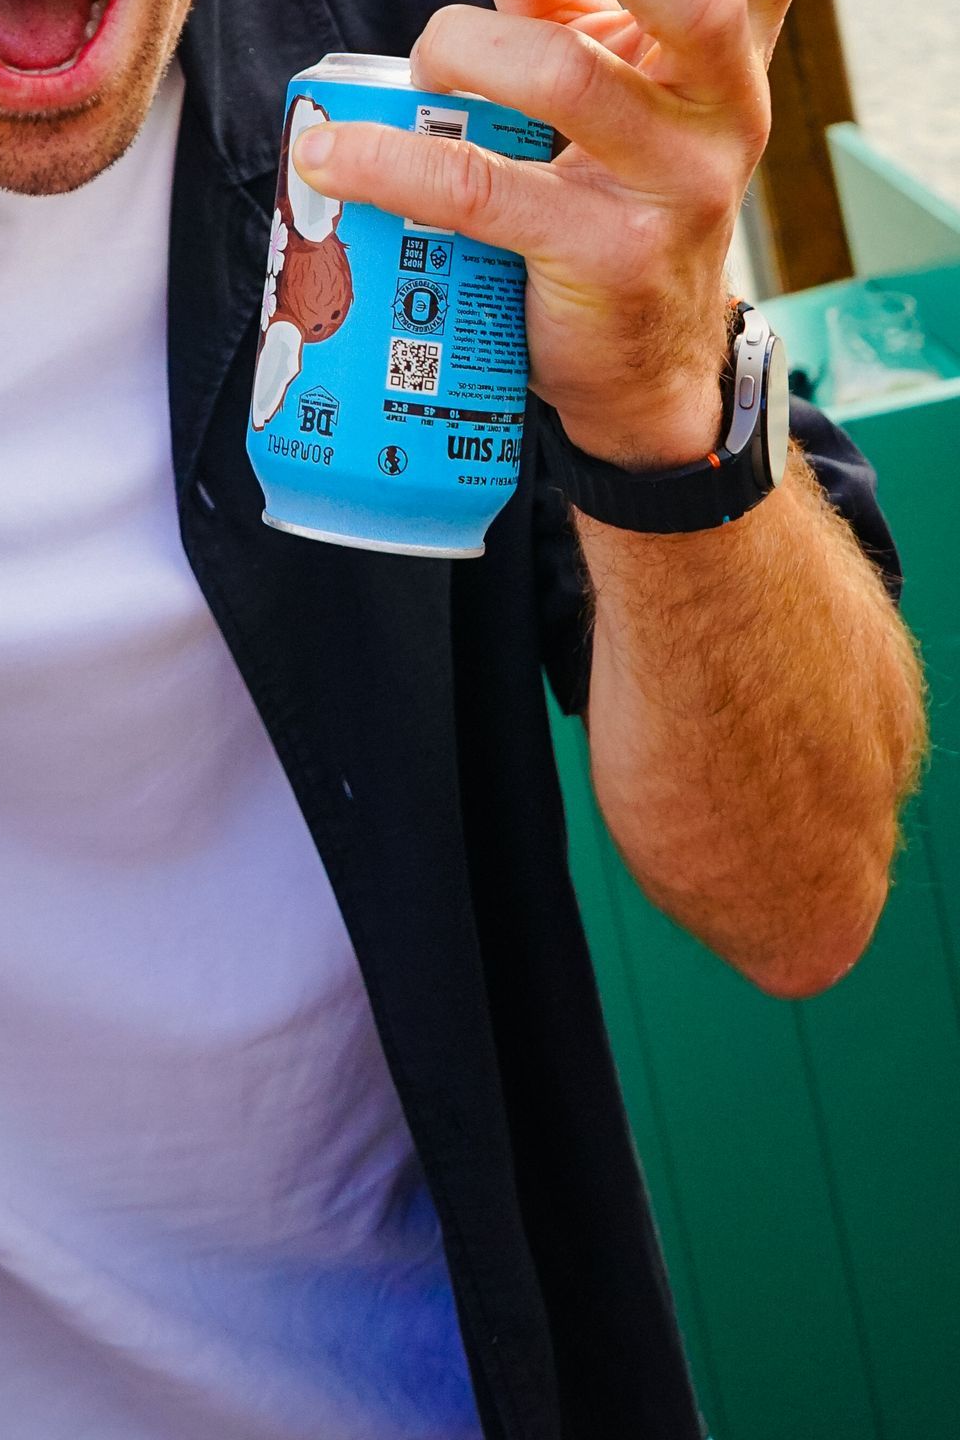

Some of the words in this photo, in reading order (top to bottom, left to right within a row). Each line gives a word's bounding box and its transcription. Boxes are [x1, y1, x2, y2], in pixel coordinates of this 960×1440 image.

[406, 239, 423, 249] FAST
[404, 248, 422, 258] FADE
[402, 258, 422, 268] HOPS
[450, 353, 470, 361] Barley
[461, 391, 482, 399] Sorachi
[423, 406, 436, 415] 45
[449, 409, 460, 418] 10
[385, 414, 406, 422] TEMP
[267, 434, 334, 465] BOMBAAI
[447, 434, 493, 462] sun
[457, 475, 486, 485] KEES
